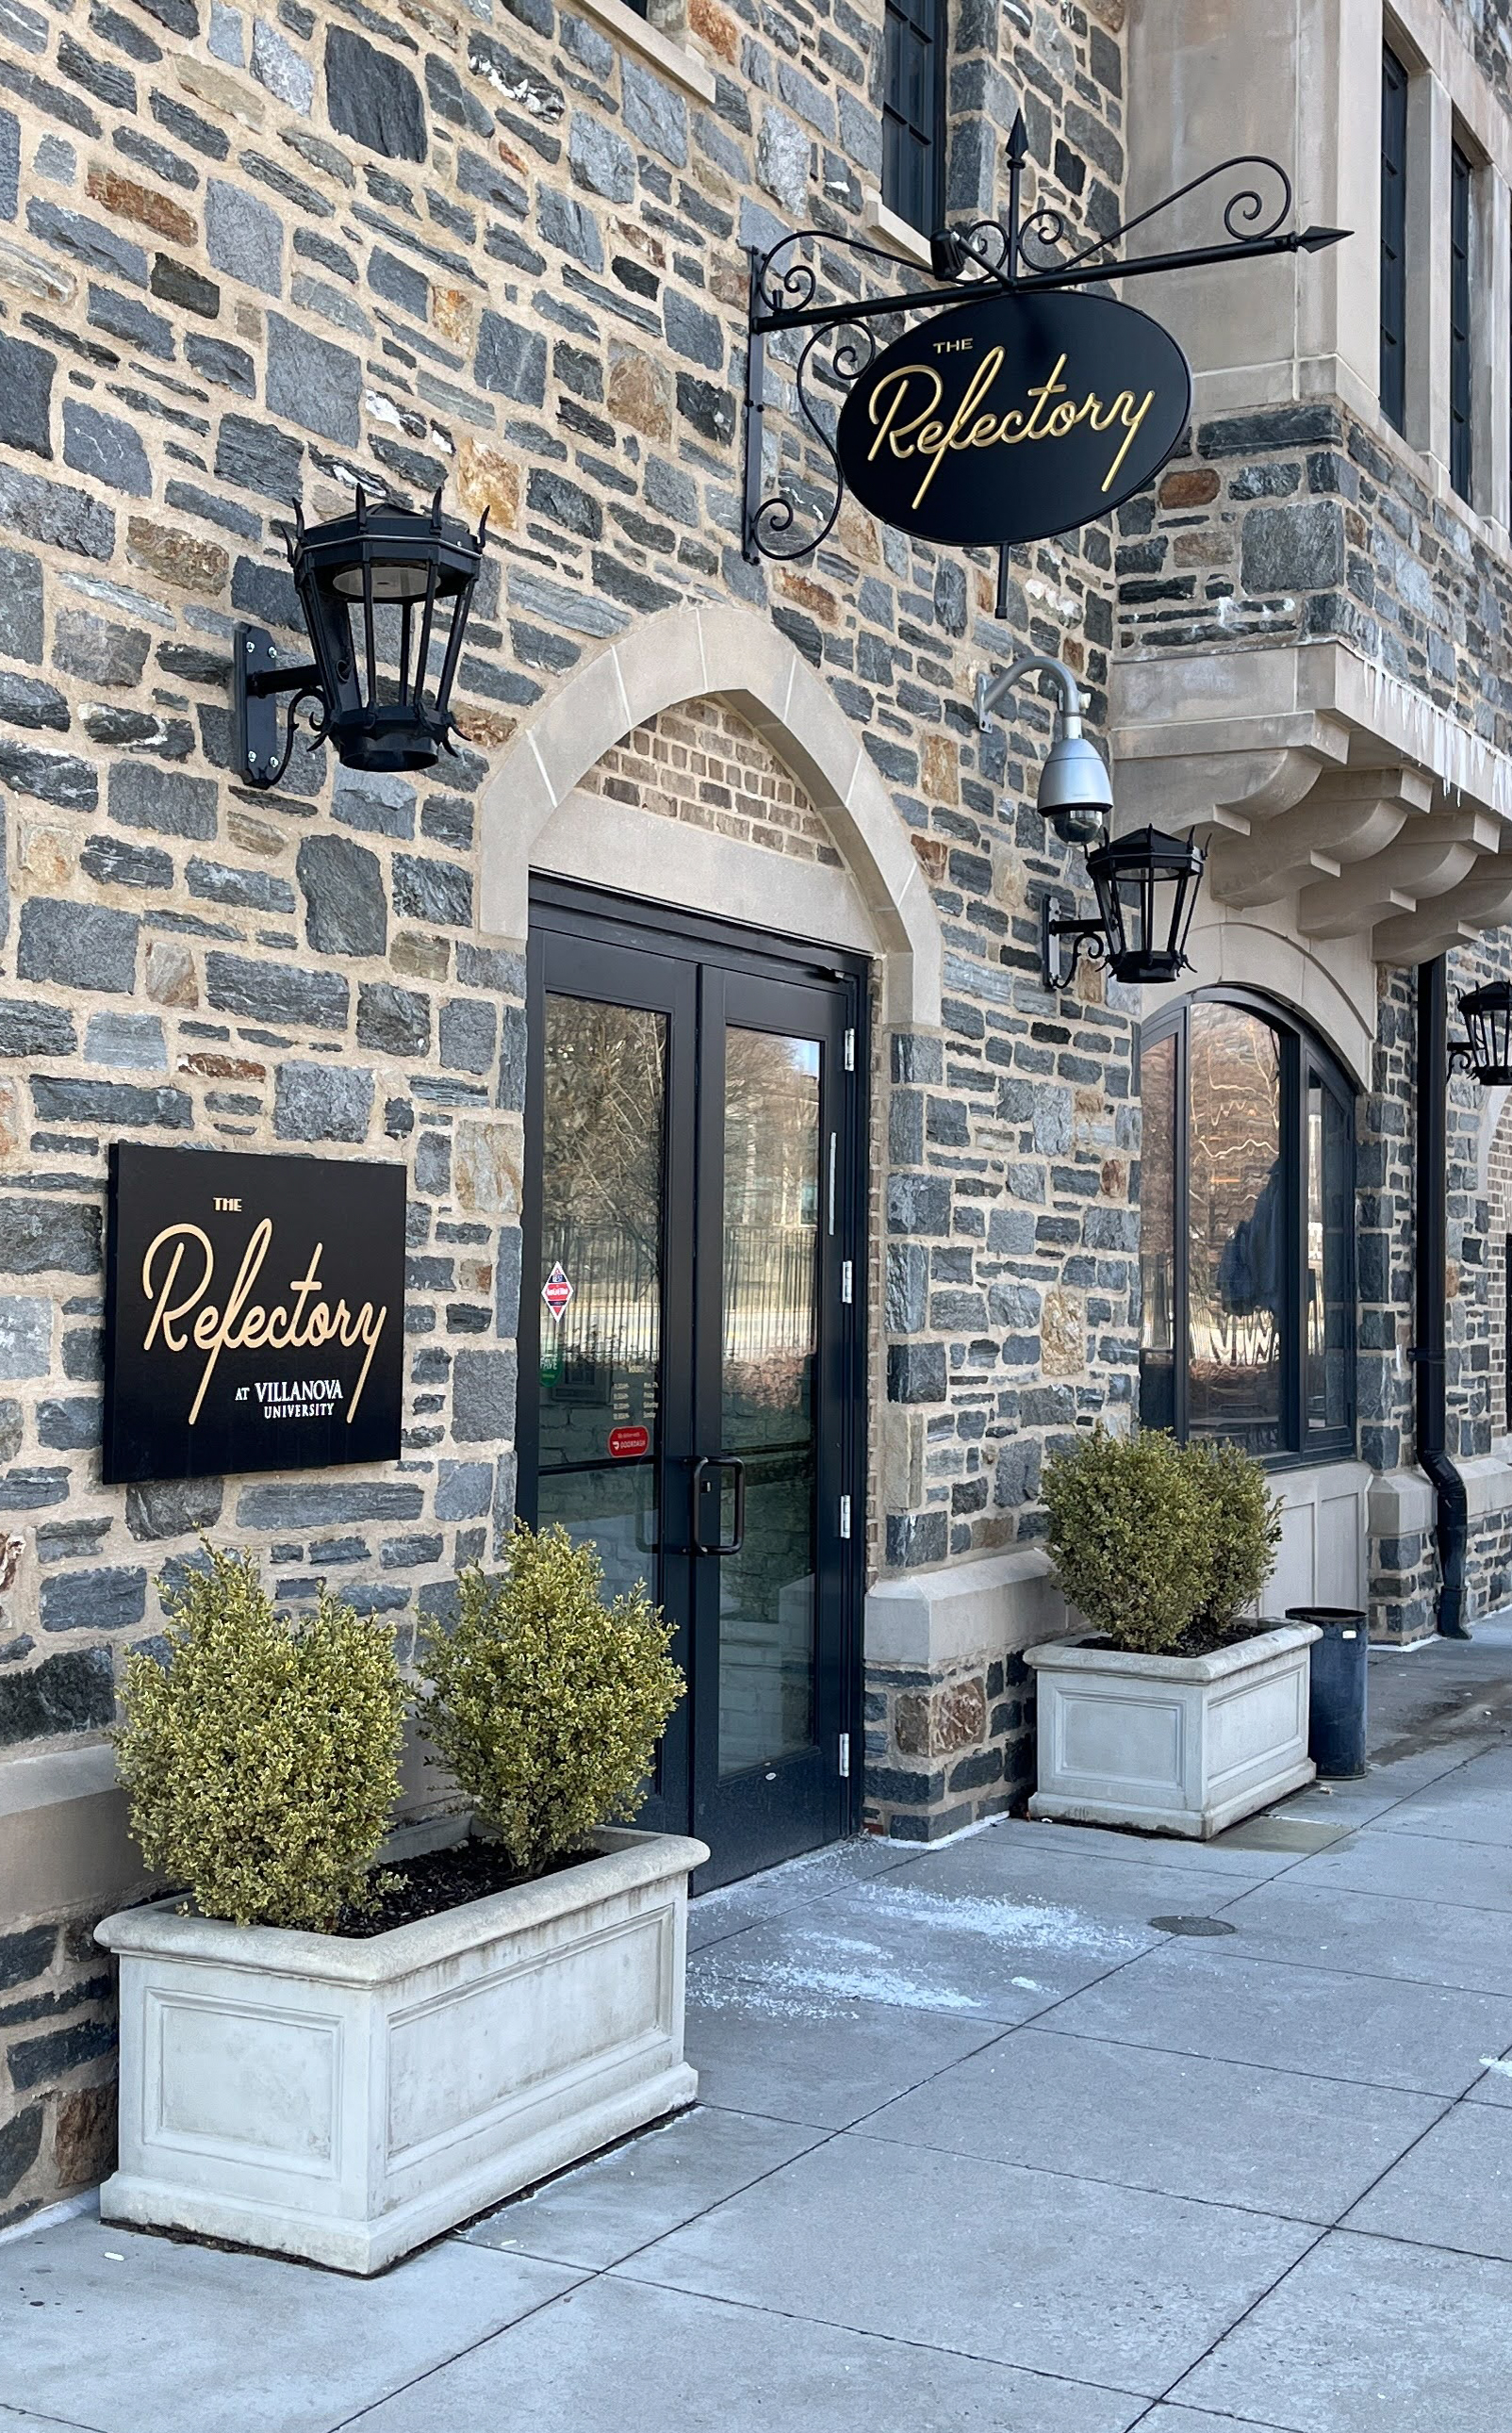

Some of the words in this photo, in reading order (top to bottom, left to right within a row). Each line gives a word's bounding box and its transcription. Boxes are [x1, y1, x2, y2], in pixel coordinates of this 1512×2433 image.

[933, 338, 974, 353] THE
[868, 346, 1155, 510] Refectory
[213, 1197, 242, 1212] THE
[142, 1218, 386, 1425] Refectory
[235, 1387, 251, 1401] AT
[255, 1379, 344, 1403] VILLANOVA
[264, 1403, 335, 1419] UNIVERSITY
